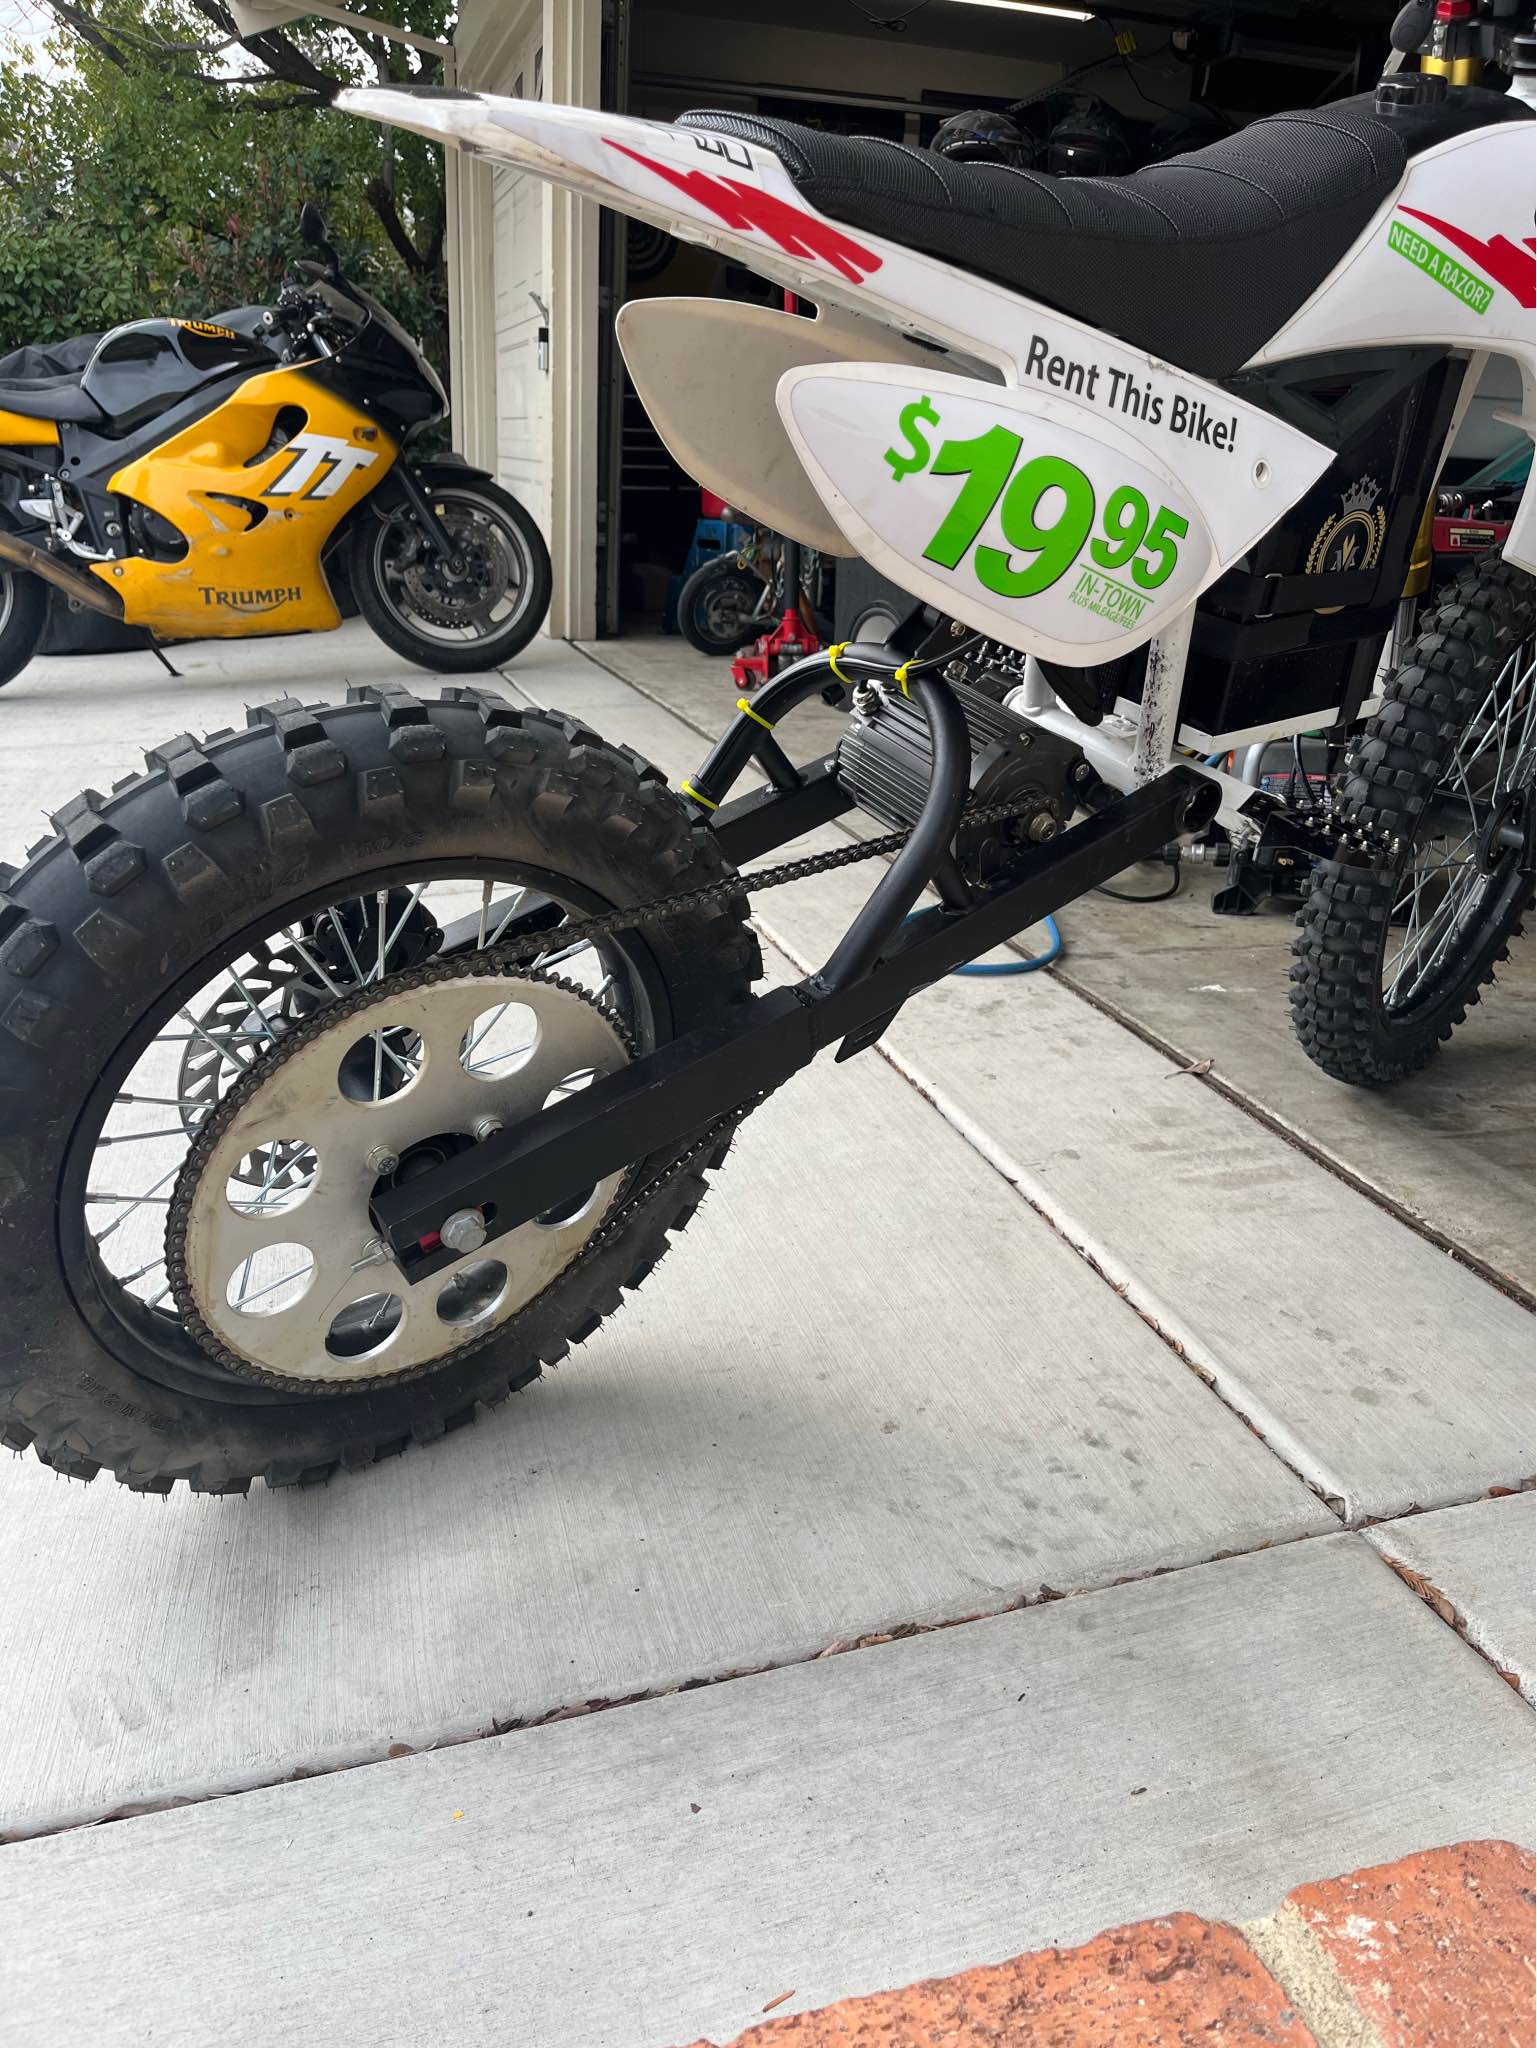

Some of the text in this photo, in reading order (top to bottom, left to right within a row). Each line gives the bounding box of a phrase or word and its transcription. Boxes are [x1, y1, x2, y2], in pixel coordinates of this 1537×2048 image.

[1390, 225, 1491, 310] NEED A RAZOR?
[1024, 334, 1238, 453] Rent This Bike!
[259, 432, 380, 500] TT
[198, 587, 302, 613] TRIUMPH
[1068, 591, 1089, 608] PLUS
[1075, 572, 1147, 620] IN-TOWN
